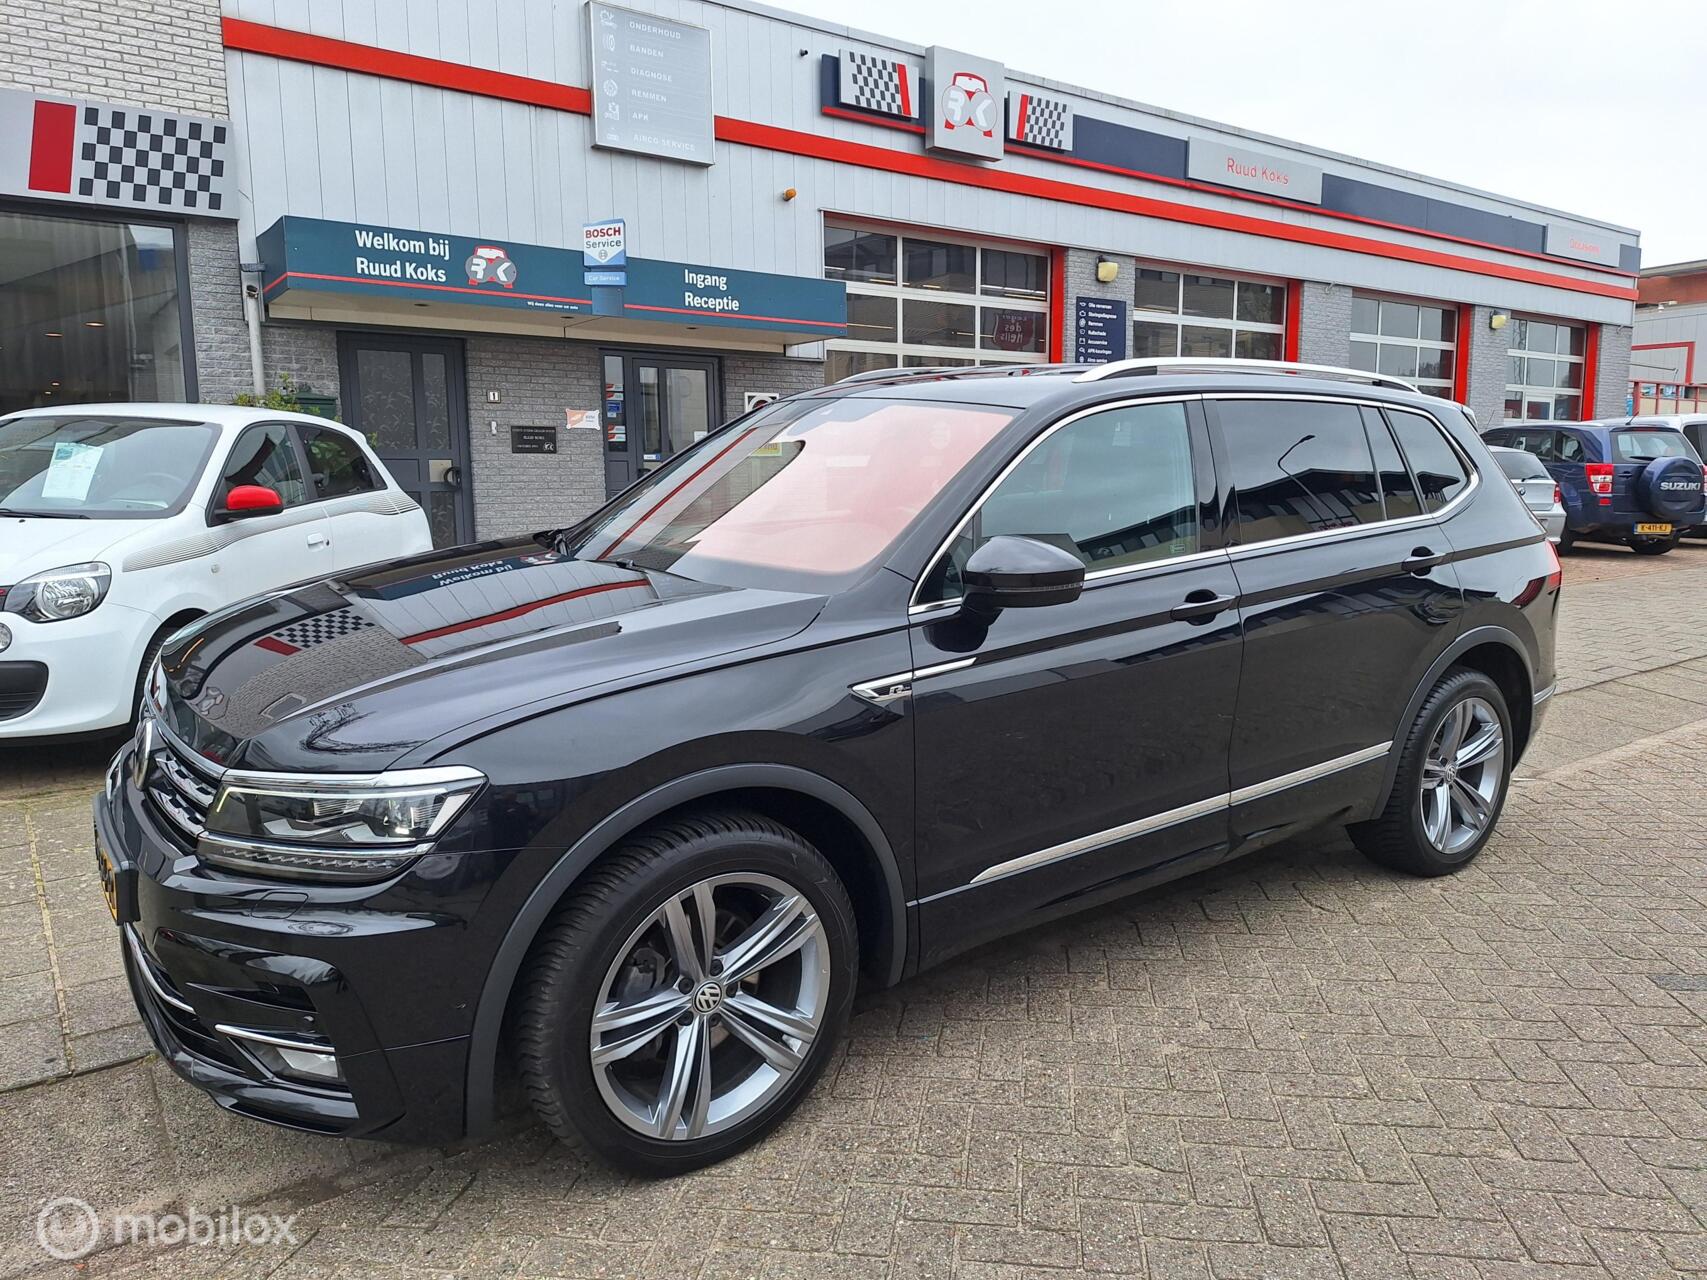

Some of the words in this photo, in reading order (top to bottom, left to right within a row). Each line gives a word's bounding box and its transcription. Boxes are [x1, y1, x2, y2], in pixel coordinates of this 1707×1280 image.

[629, 21, 681, 40] ONDERHOUD
[629, 44, 664, 58] BANDEN
[631, 67, 673, 82] DIAGNOSE
[631, 89, 667, 103] REMMEN
[632, 112, 649, 121] APK
[633, 134, 660, 147] AIRCO
[661, 138, 696, 152] SERVICE
[1227, 157, 1257, 178] Ruud
[1261, 167, 1289, 185] Koks
[585, 226, 621, 239] BOSCH
[355, 230, 425, 254] Welkom
[428, 237, 450, 261] bij
[585, 238, 622, 249] Service
[356, 257, 401, 278] Ruud
[405, 261, 447, 283] Koks
[684, 268, 727, 291] Ingang
[684, 291, 740, 313] Receptie
[1660, 481, 1702, 491] SUZUKI
